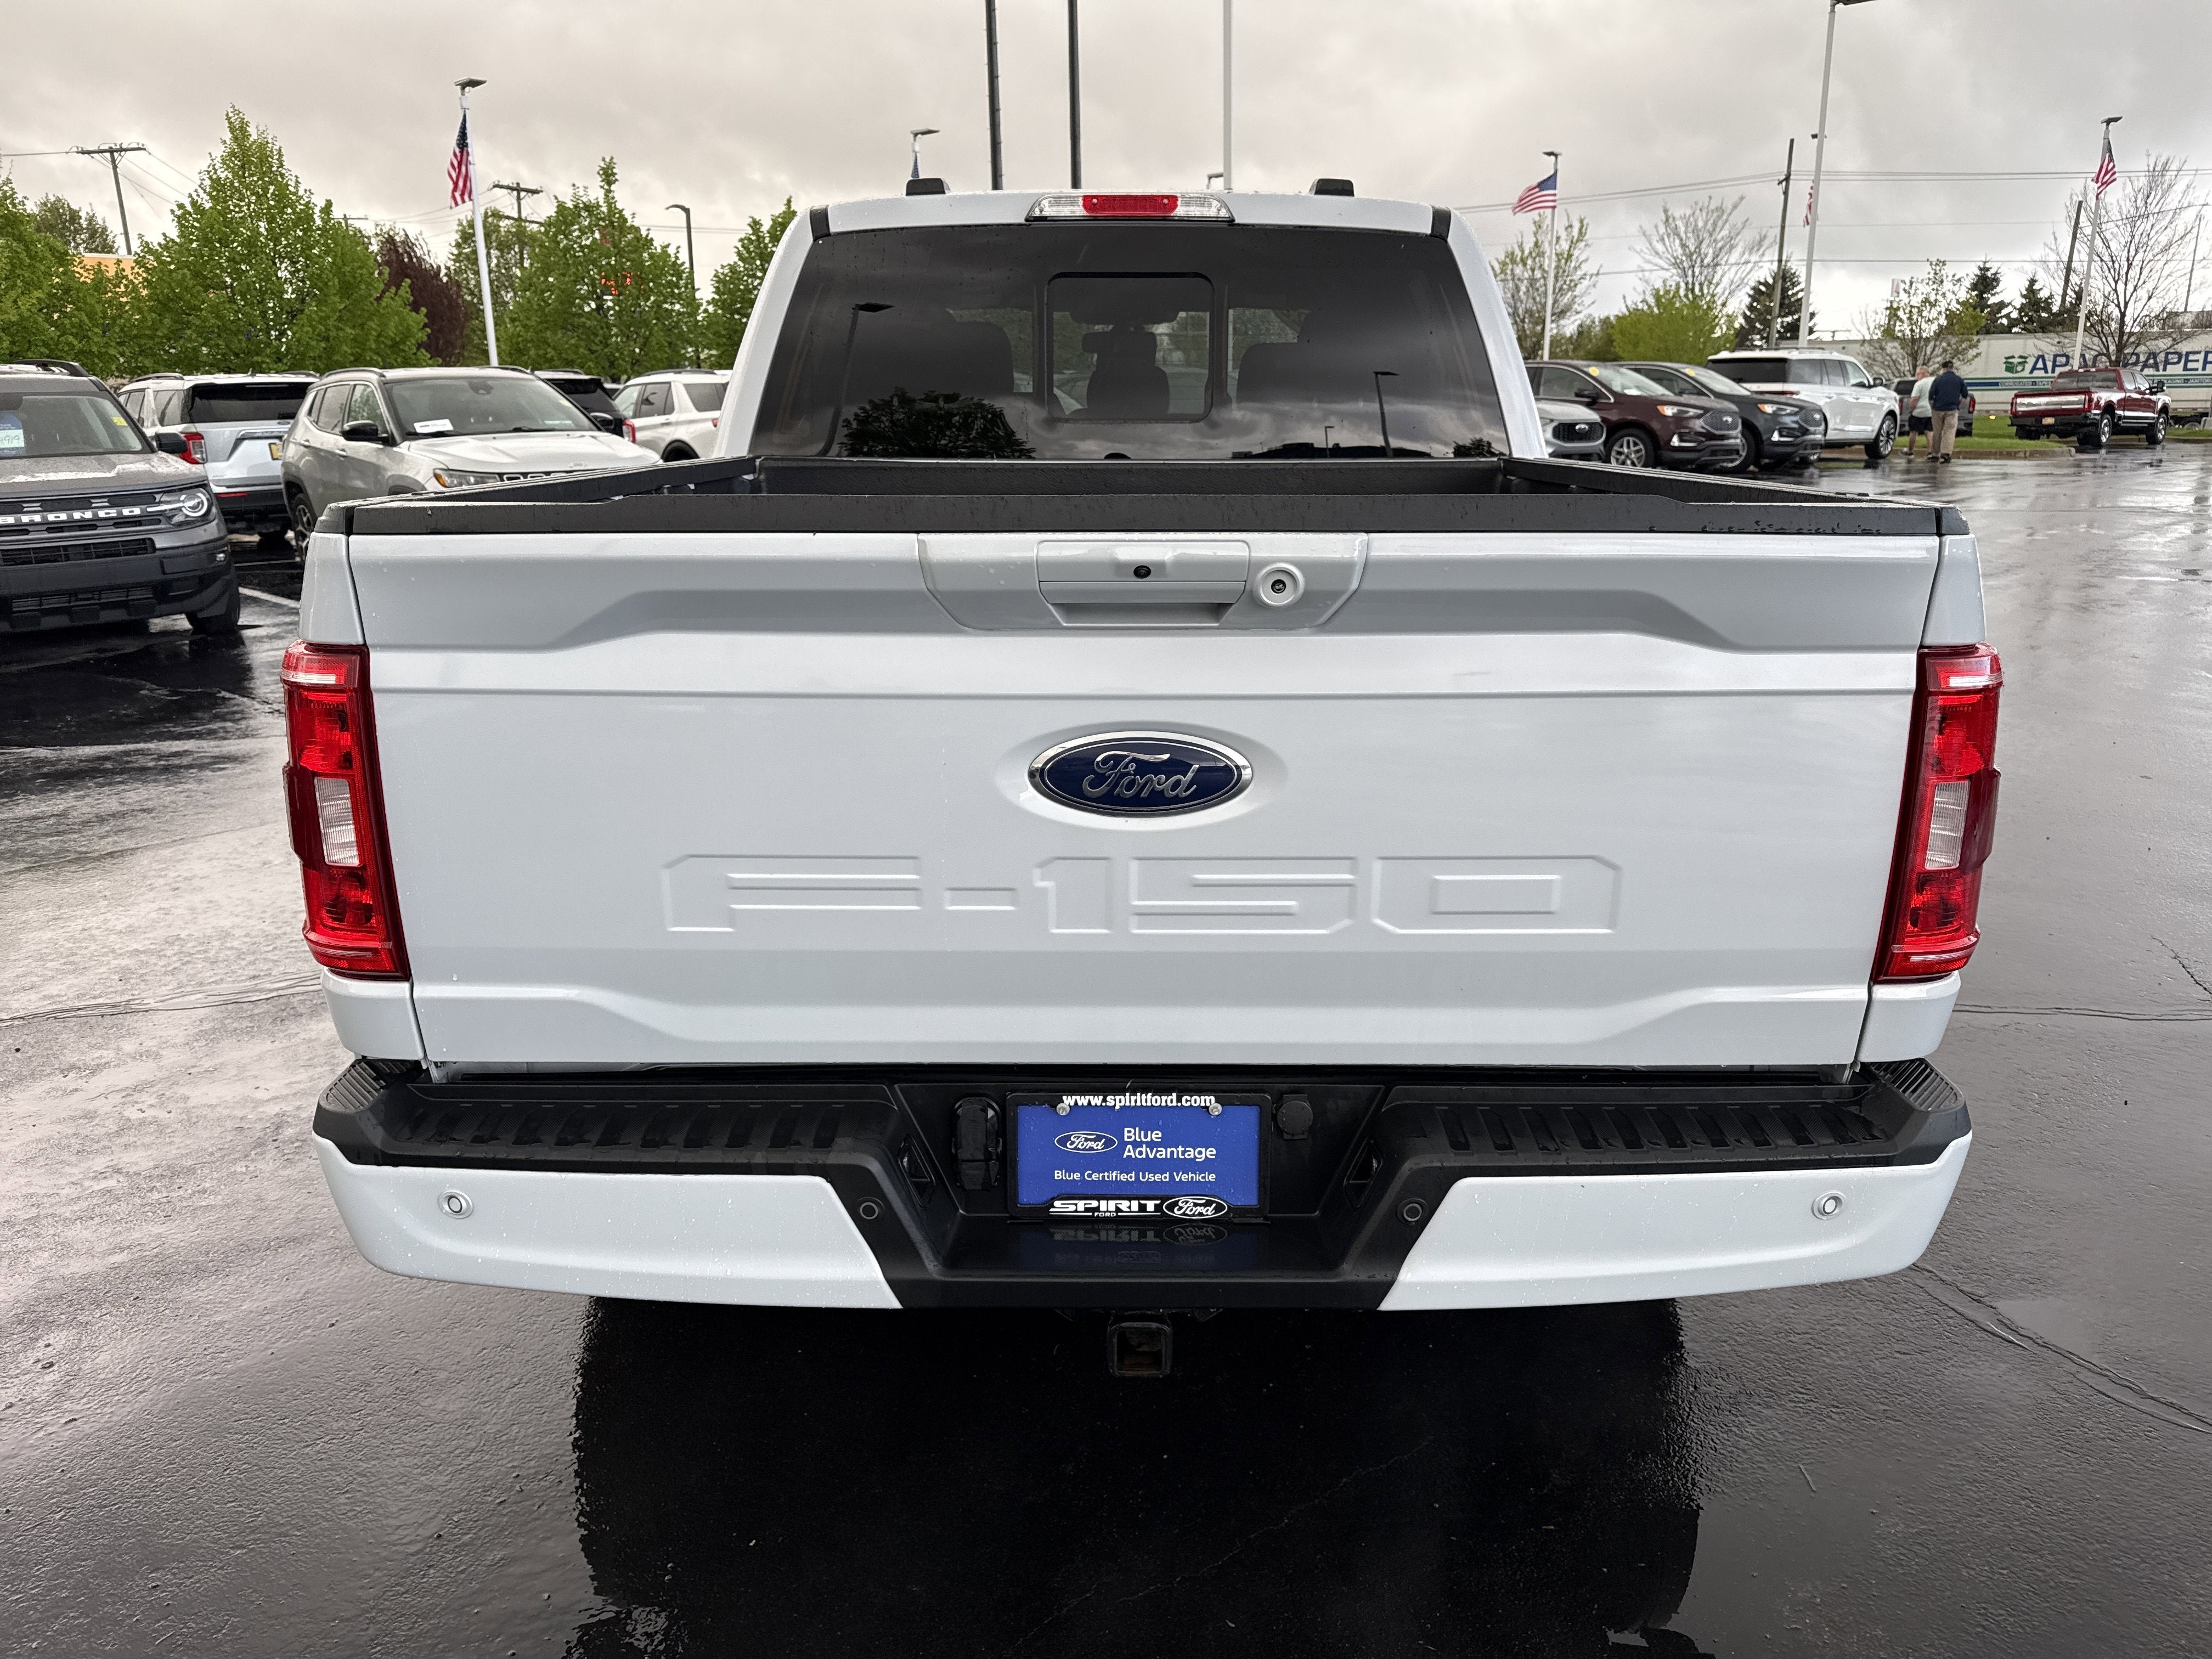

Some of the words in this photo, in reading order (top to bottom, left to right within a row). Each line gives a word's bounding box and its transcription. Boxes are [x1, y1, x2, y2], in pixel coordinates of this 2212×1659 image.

[0, 507, 141, 524] BRONCO
[1082, 751, 1200, 798] Ford
[661, 854, 1622, 934] F-150
[1063, 1092, 1215, 1109] www.spiritford.com
[1066, 1133, 1106, 1150] Ford
[1124, 1127, 1163, 1142] Blue
[1123, 1144, 1216, 1161] Advantage
[1054, 1170, 1081, 1180] Blue
[1084, 1171, 1135, 1181] Certified
[1139, 1171, 1169, 1182] Used
[1173, 1171, 1216, 1182] Vehicle
[1049, 1200, 1161, 1212] SPIRIT
[1173, 1199, 1216, 1216] Ford
